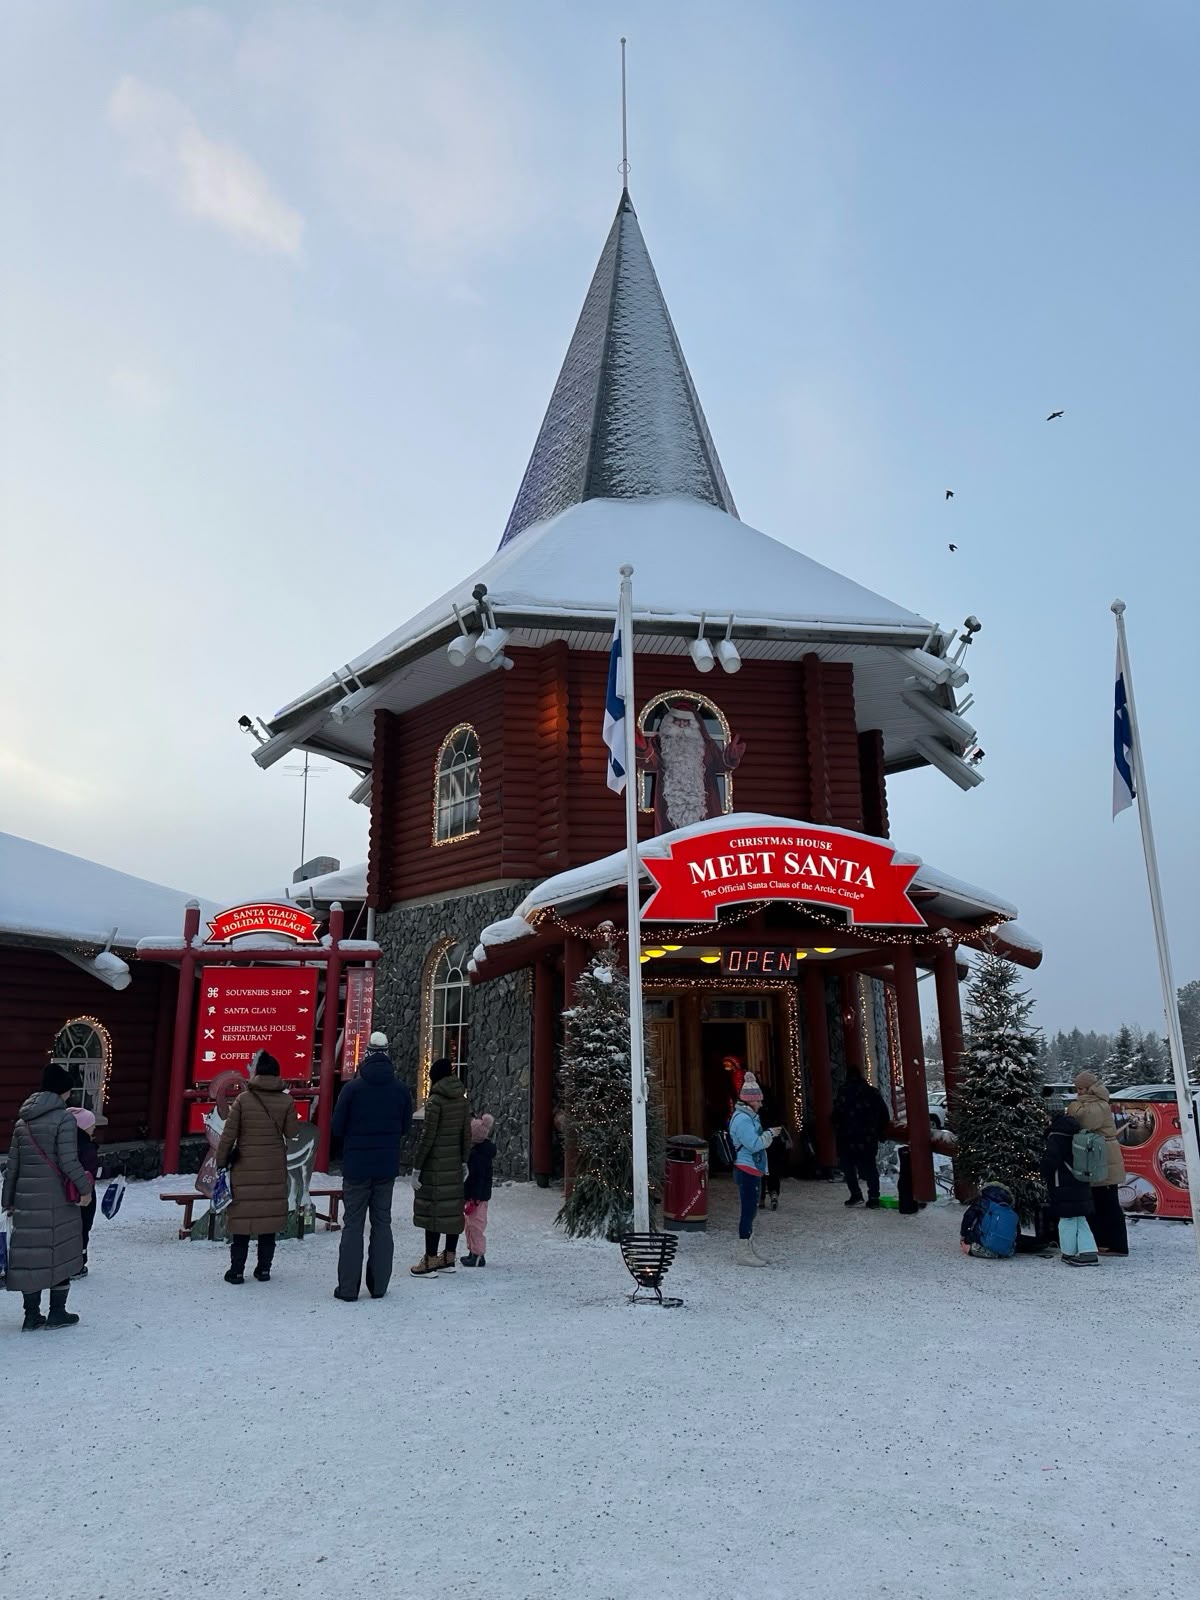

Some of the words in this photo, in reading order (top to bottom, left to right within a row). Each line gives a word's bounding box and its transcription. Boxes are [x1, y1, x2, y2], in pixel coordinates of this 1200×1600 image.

[729, 836, 794, 849] CHRISTMAS
[796, 837, 833, 851] HOUSE
[687, 852, 776, 885] MEET
[784, 851, 876, 890] SANTA
[701, 888, 717, 899] The
[718, 883, 746, 895] Official
[747, 881, 768, 890] Santa
[769, 880, 791, 890] Claus
[791, 881, 800, 890] of
[801, 880, 813, 890] the
[815, 882, 837, 895] Arctic
[233, 908, 264, 920] SANTA
[267, 909, 298, 921] CLAUS
[222, 917, 265, 934] HOLIDAY
[268, 917, 307, 934] VILLAGE
[729, 951, 792, 971] OPEN
[222, 1025, 268, 1033] CHRISTMAS
[270, 1024, 297, 1032] HOUSE
[220, 1052, 250, 1060] COFFEE
